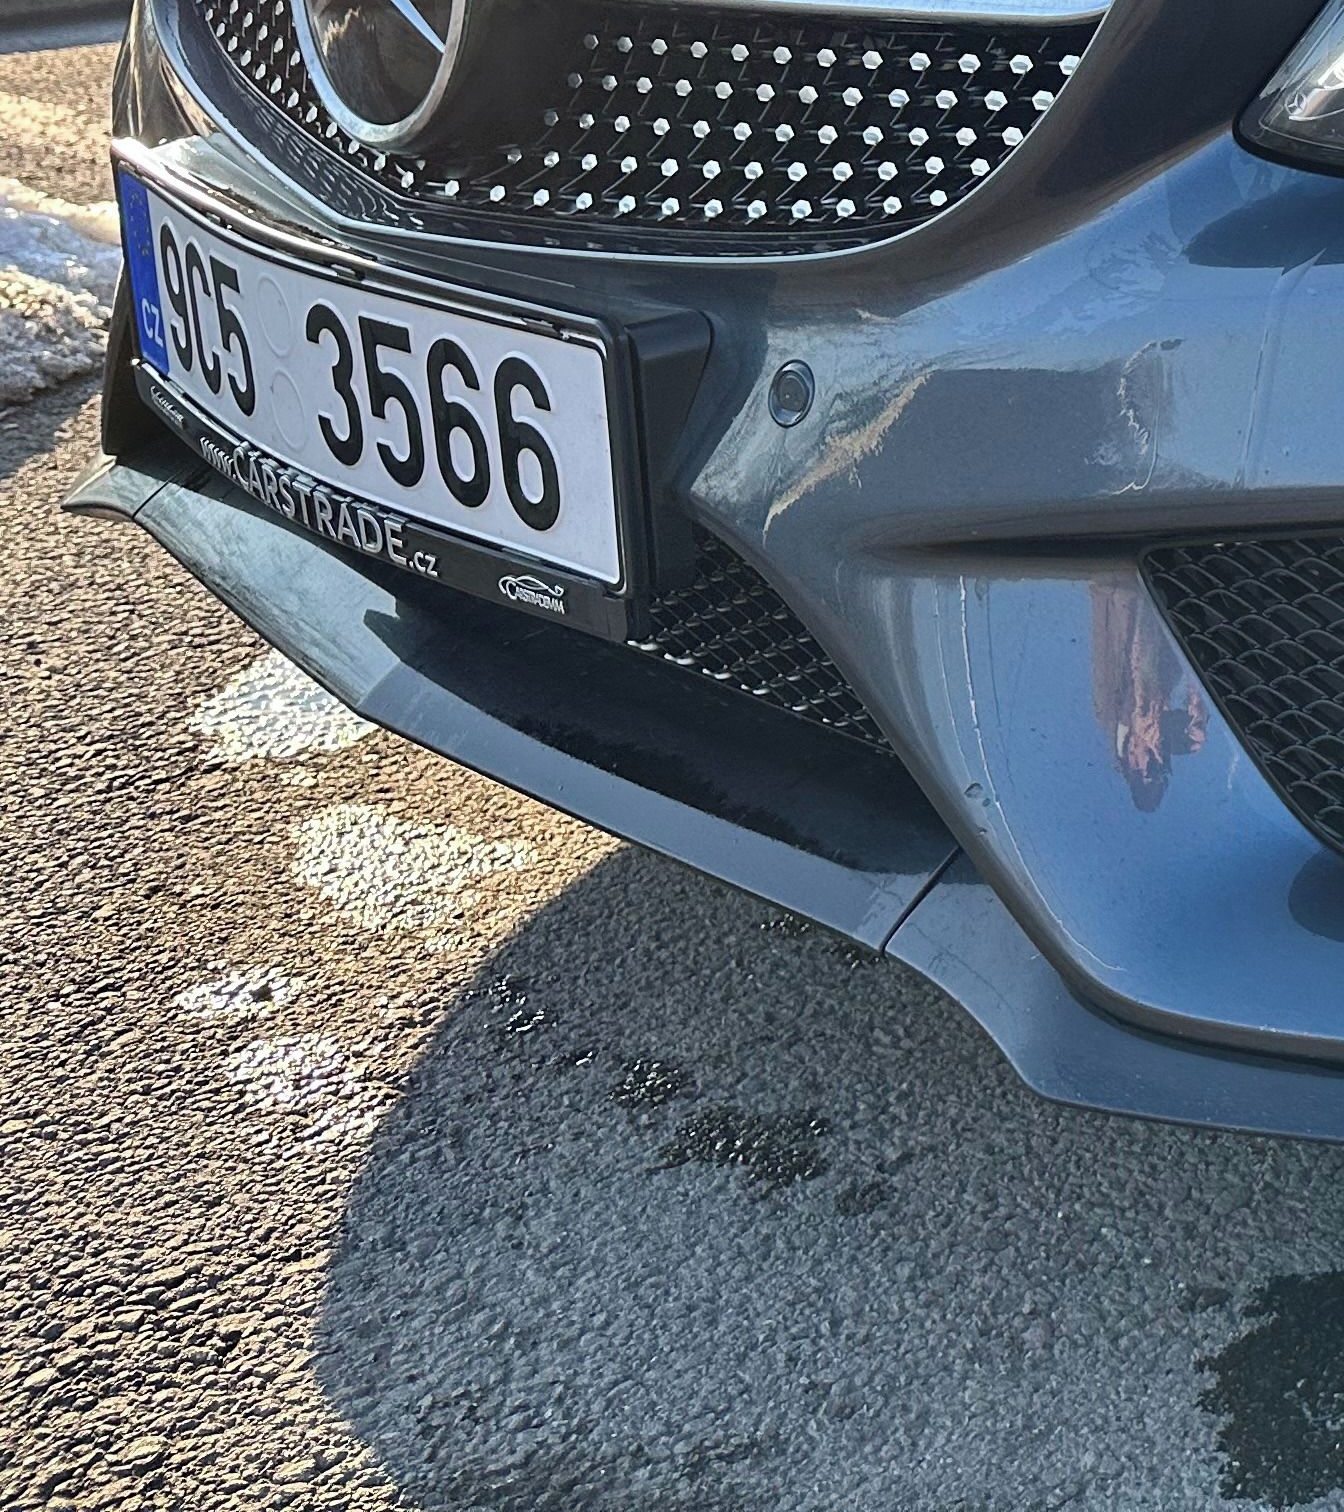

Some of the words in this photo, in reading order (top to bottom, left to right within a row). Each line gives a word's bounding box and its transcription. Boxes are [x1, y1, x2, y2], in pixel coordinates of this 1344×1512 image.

[142, 298, 164, 348] CZ
[160, 223, 256, 417] 9C5
[305, 303, 561, 532] 3566
[200, 436, 438, 578] www.CARSTRADE.cz
